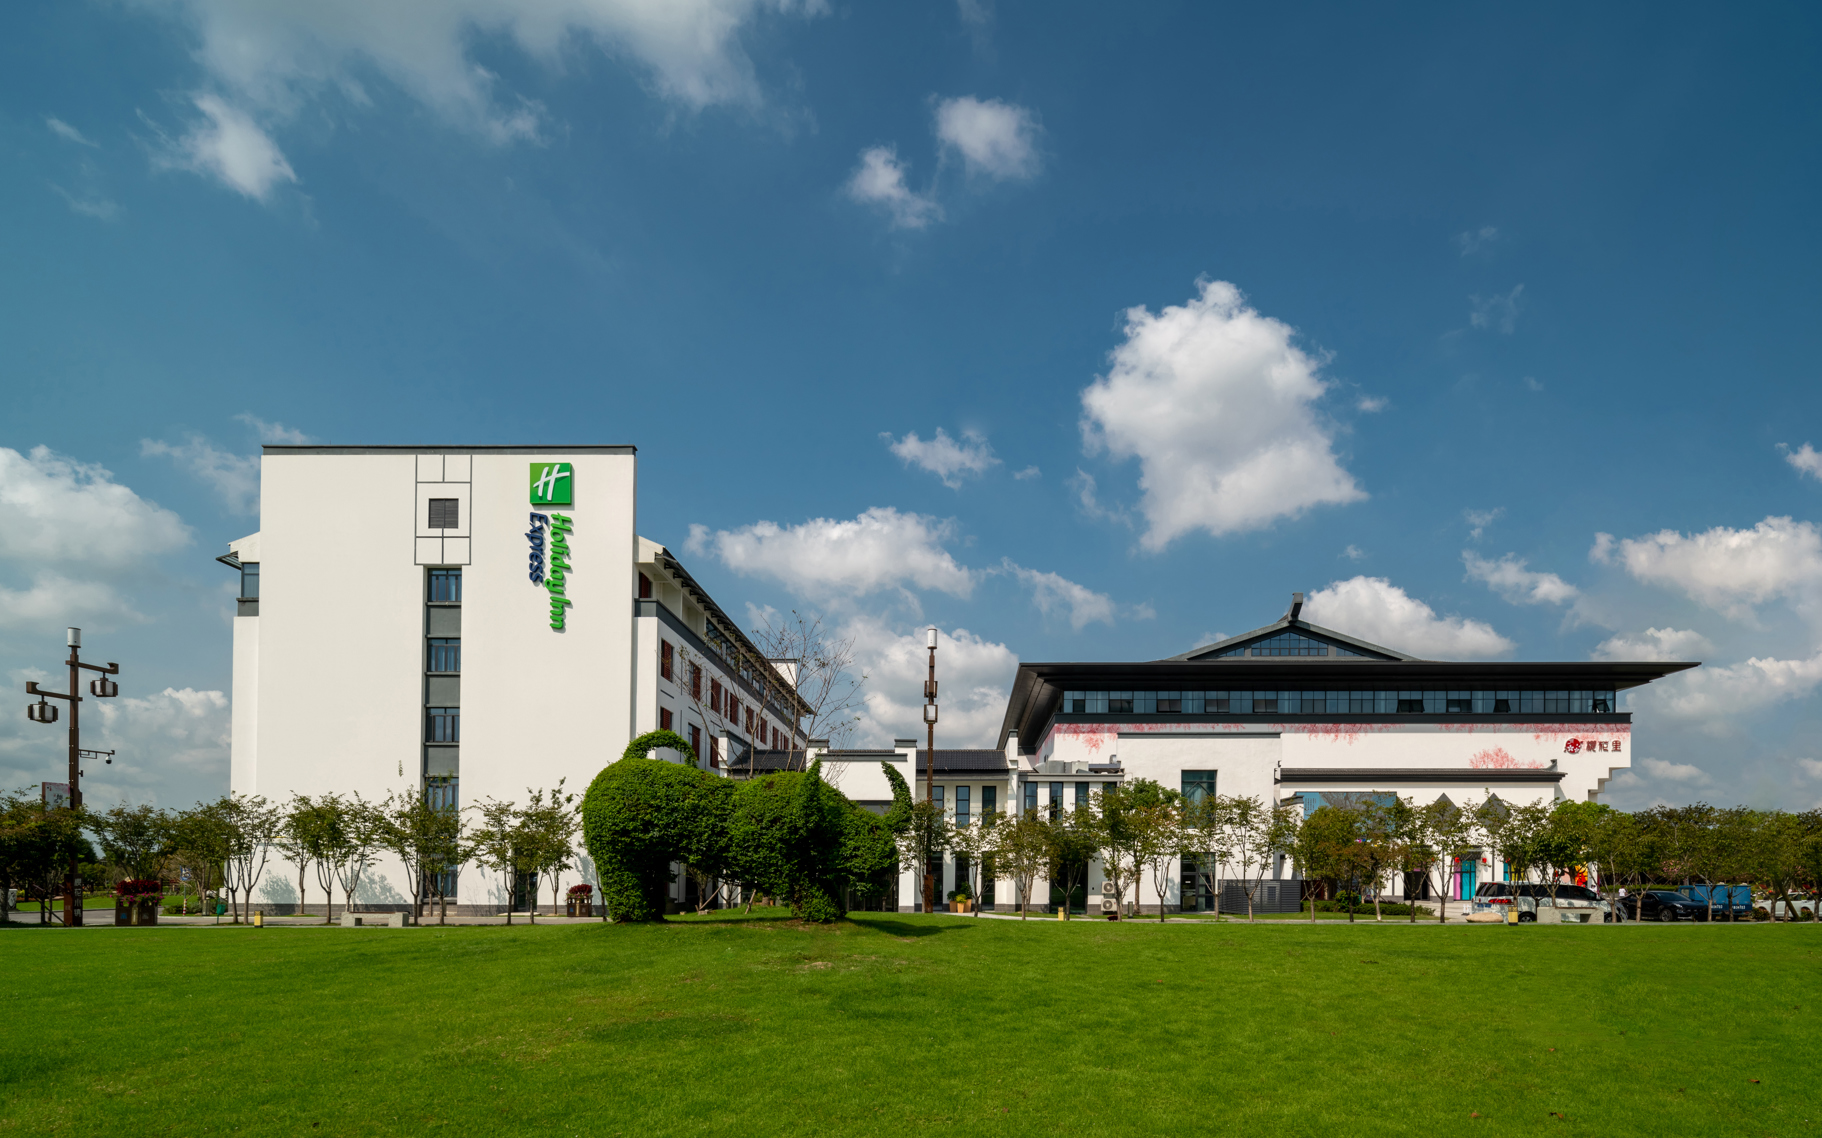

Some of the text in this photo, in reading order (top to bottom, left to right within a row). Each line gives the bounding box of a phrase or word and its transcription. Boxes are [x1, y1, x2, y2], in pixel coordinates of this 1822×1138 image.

[525, 511, 548, 583] Express
[544, 512, 572, 629] Holiday Inn
